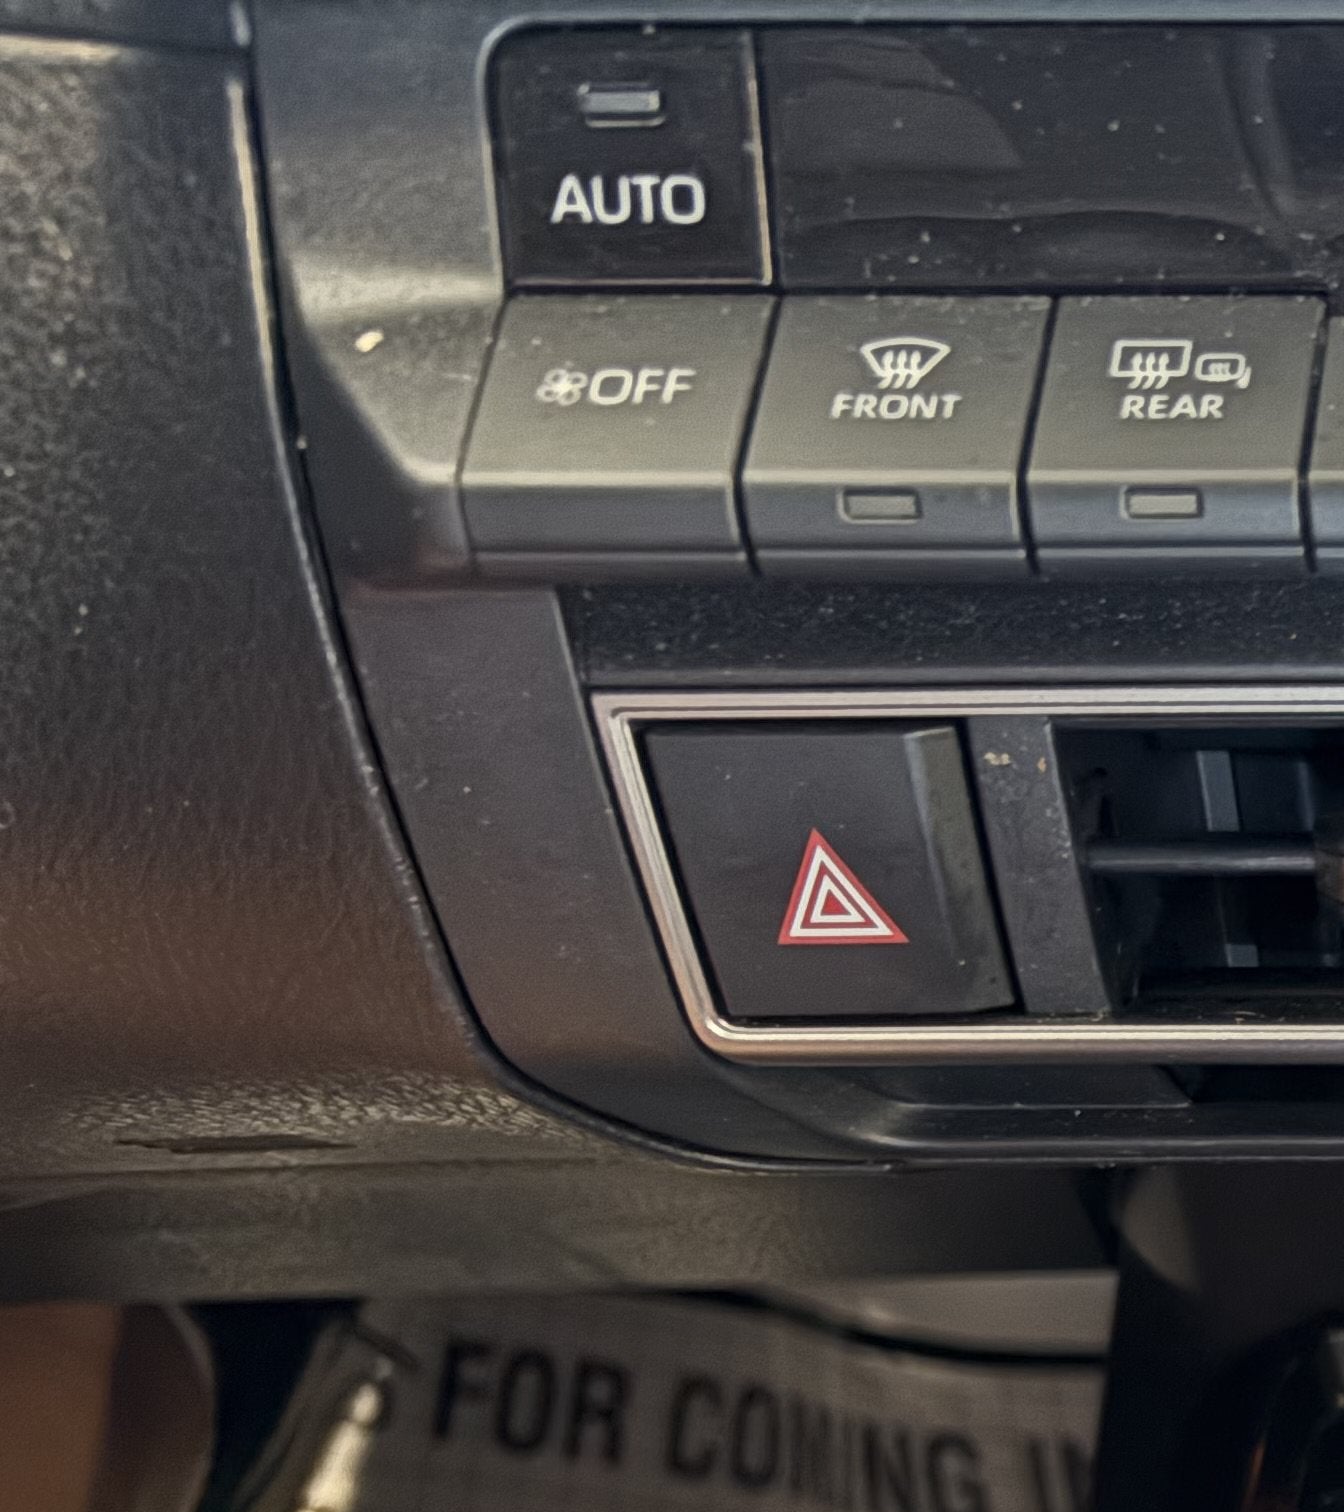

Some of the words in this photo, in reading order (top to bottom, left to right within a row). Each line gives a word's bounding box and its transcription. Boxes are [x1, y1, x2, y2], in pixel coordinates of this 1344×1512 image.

[550, 174, 706, 225] AUTO
[588, 368, 697, 406] OFF
[830, 393, 963, 420] FRONT
[1119, 394, 1225, 420] REAR
[432, 1338, 631, 1466] FOR
